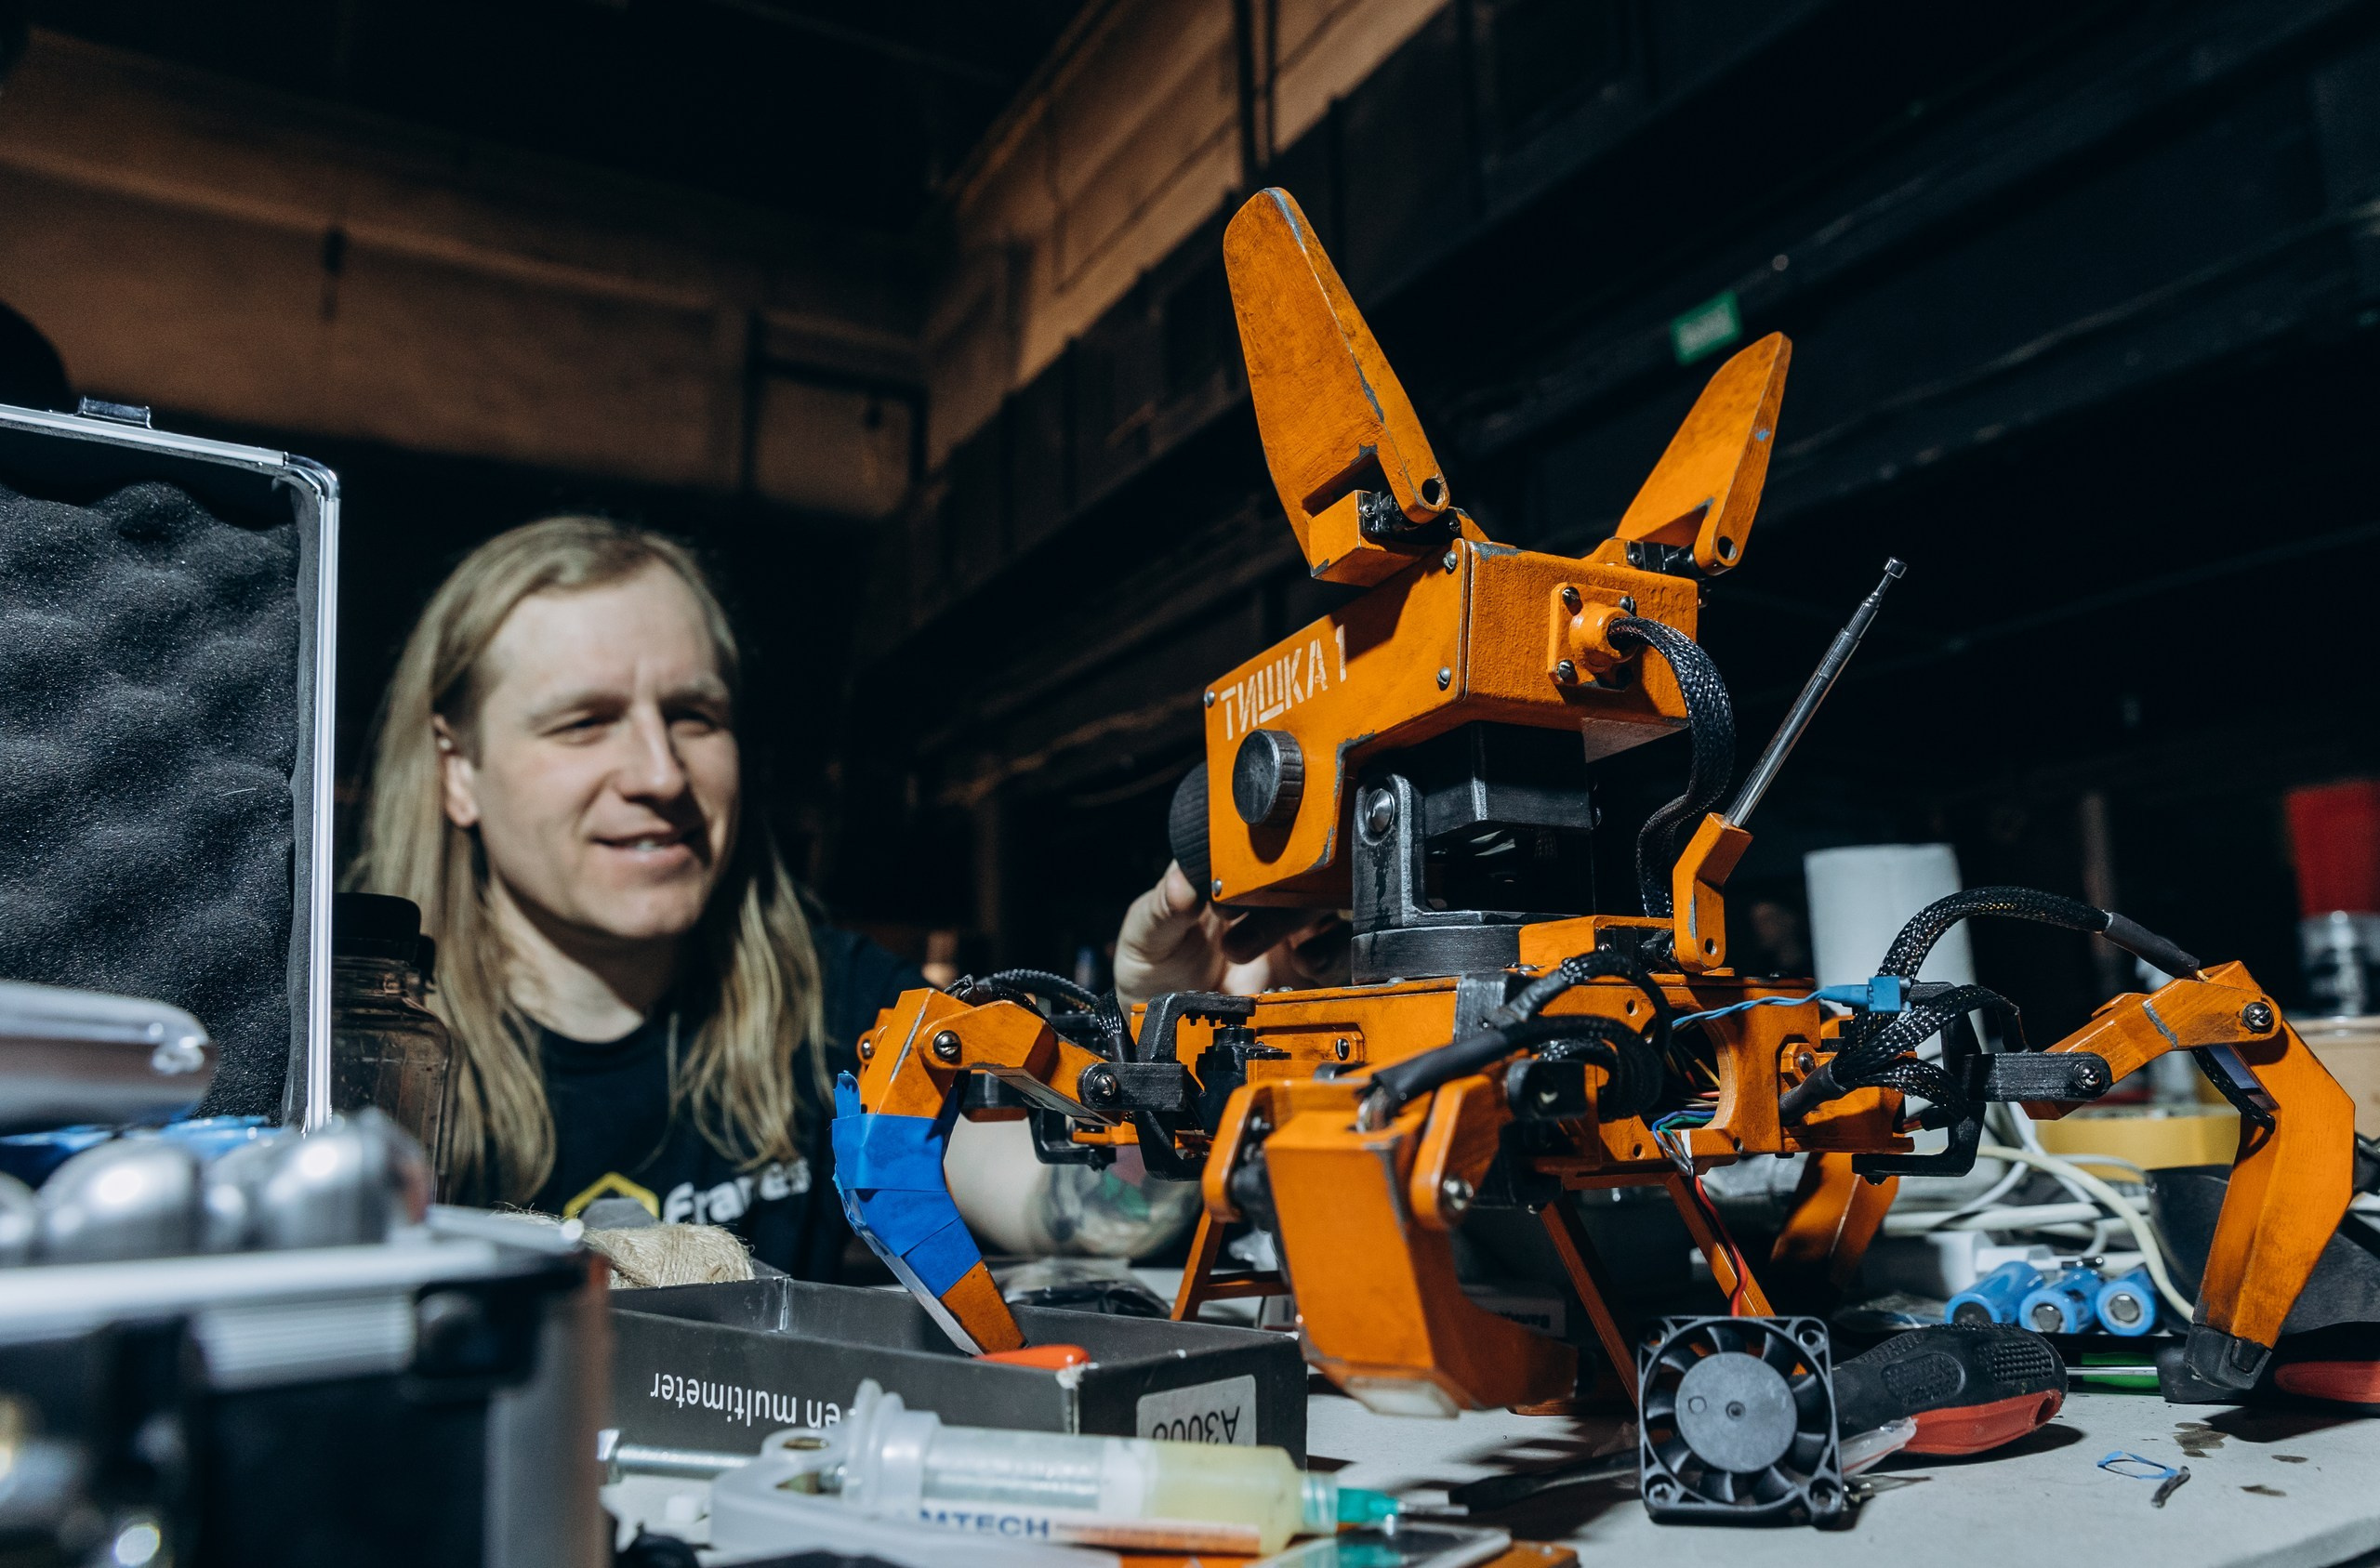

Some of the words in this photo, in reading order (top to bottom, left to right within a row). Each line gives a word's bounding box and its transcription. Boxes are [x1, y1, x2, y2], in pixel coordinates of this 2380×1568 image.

[1220, 638, 1329, 741] ТИШКА
[1335, 624, 1347, 683] 1
[650, 1372, 797, 1428] multimeter
